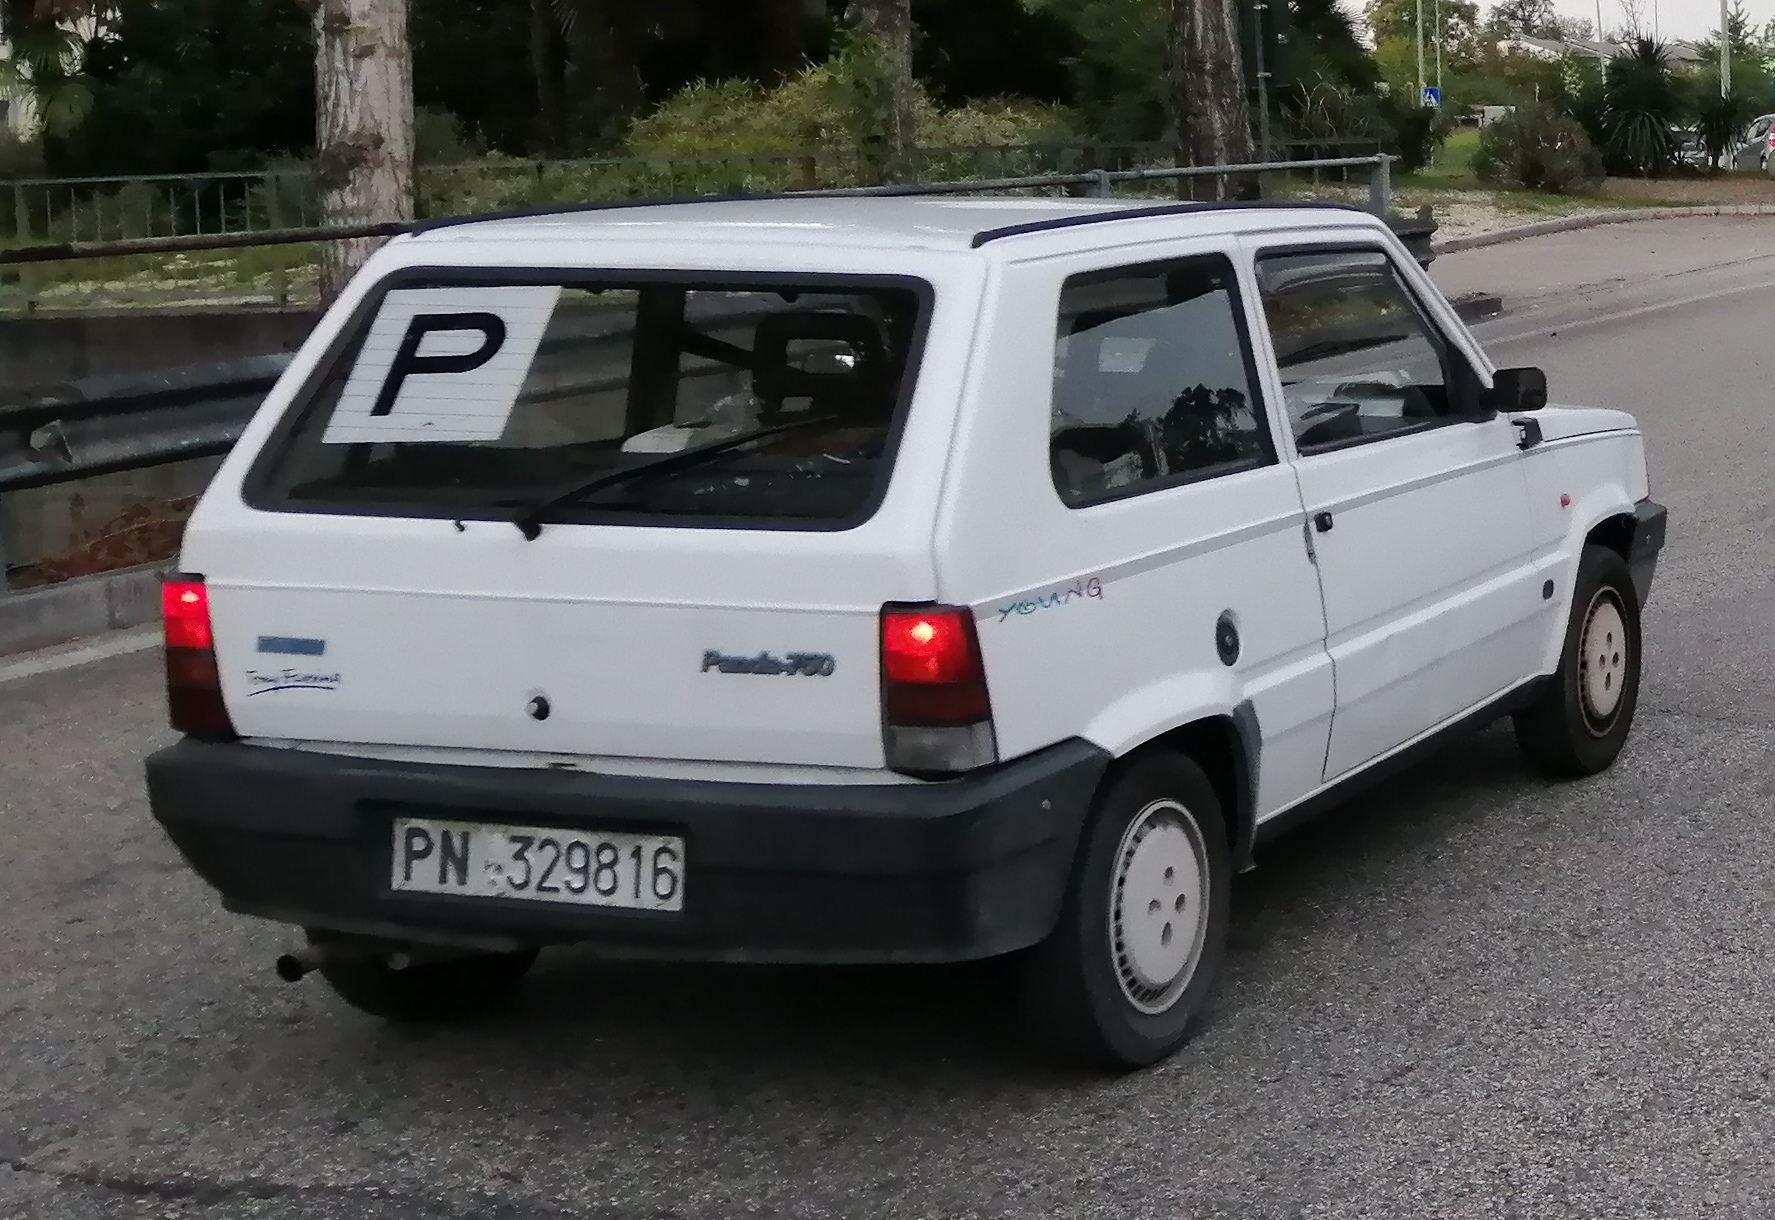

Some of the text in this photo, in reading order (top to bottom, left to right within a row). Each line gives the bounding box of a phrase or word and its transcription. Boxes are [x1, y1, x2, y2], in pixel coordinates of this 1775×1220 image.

[370, 312, 506, 416] P
[998, 577, 1103, 623] YOUNG
[404, 827, 680, 900] PN 329816
